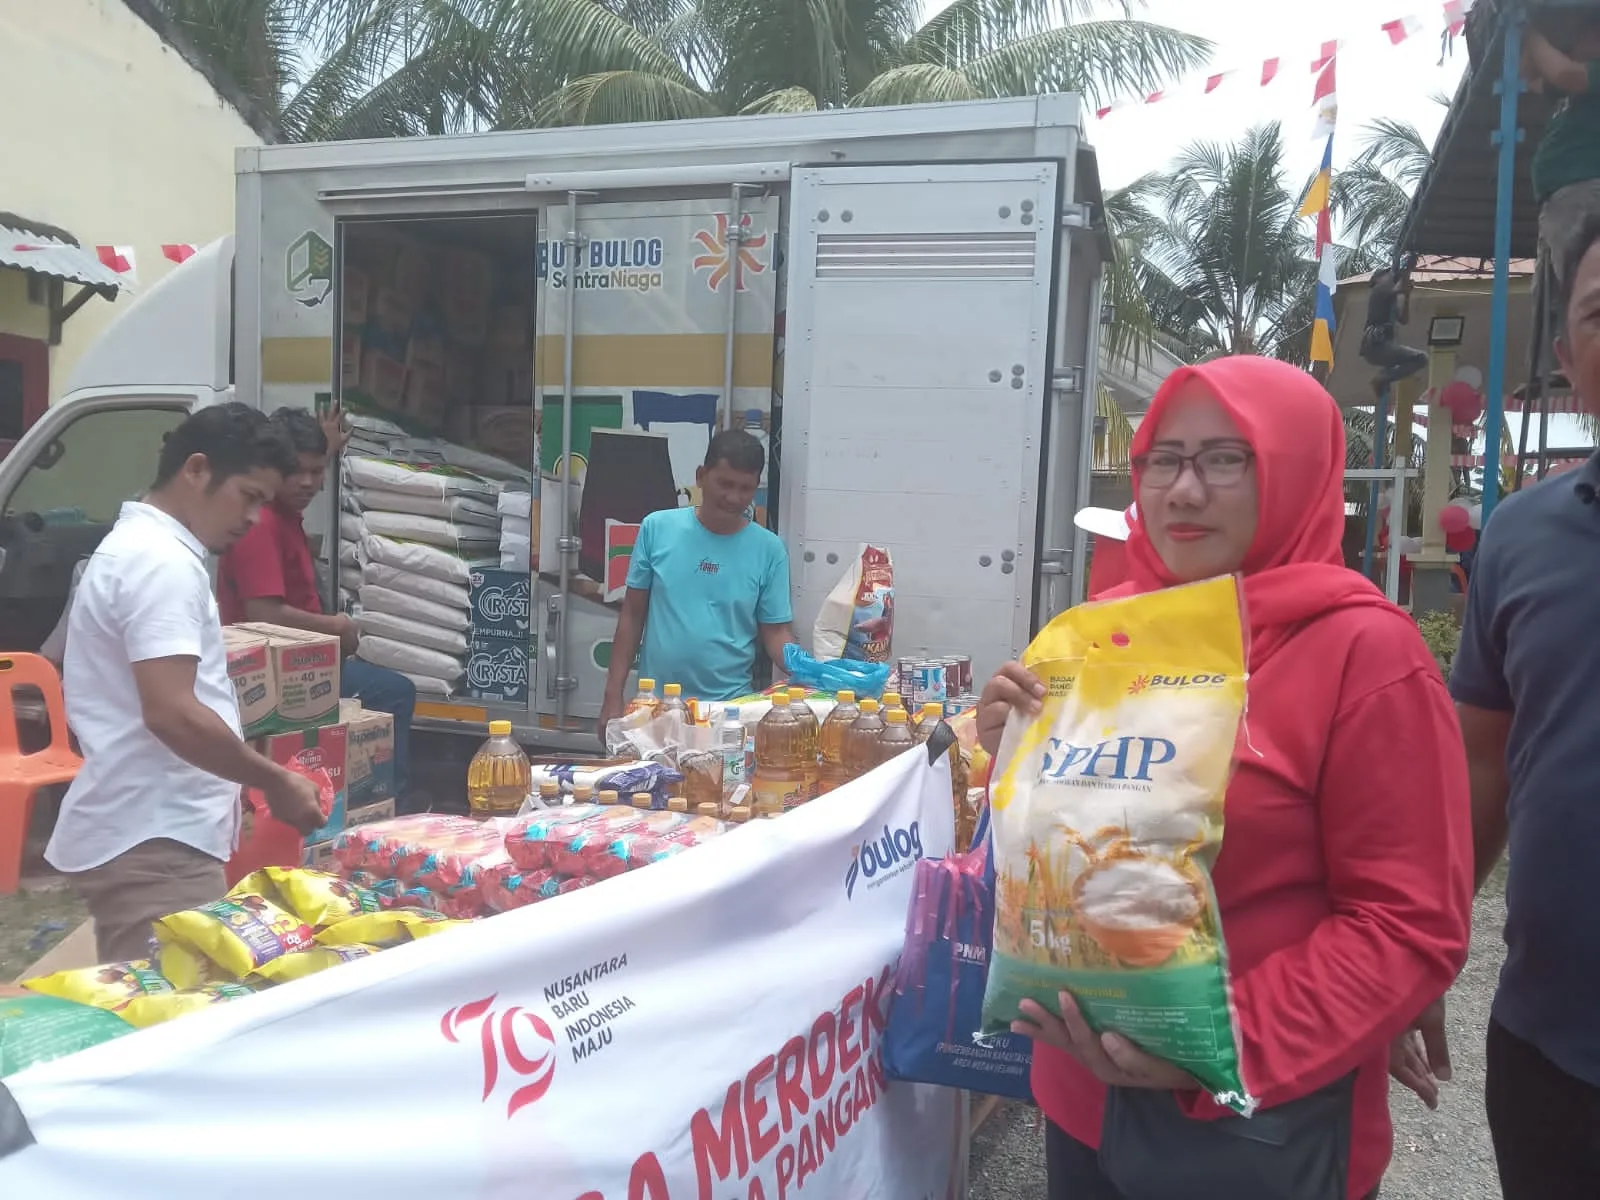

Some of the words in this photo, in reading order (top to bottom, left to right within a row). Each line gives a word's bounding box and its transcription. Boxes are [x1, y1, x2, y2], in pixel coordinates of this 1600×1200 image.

[590, 239, 662, 268] BULOG
[301, 672, 315, 683] 40
[1150, 673, 1227, 687] BULOG
[860, 821, 924, 878] bulog
[543, 952, 628, 1003] NUSANTARA
[551, 991, 590, 1020] BARU
[565, 995, 636, 1043] INDONESIA
[572, 1026, 613, 1064] MAJU
[691, 963, 893, 1200] MERDEK
[776, 1049, 889, 1200] PANGAN
